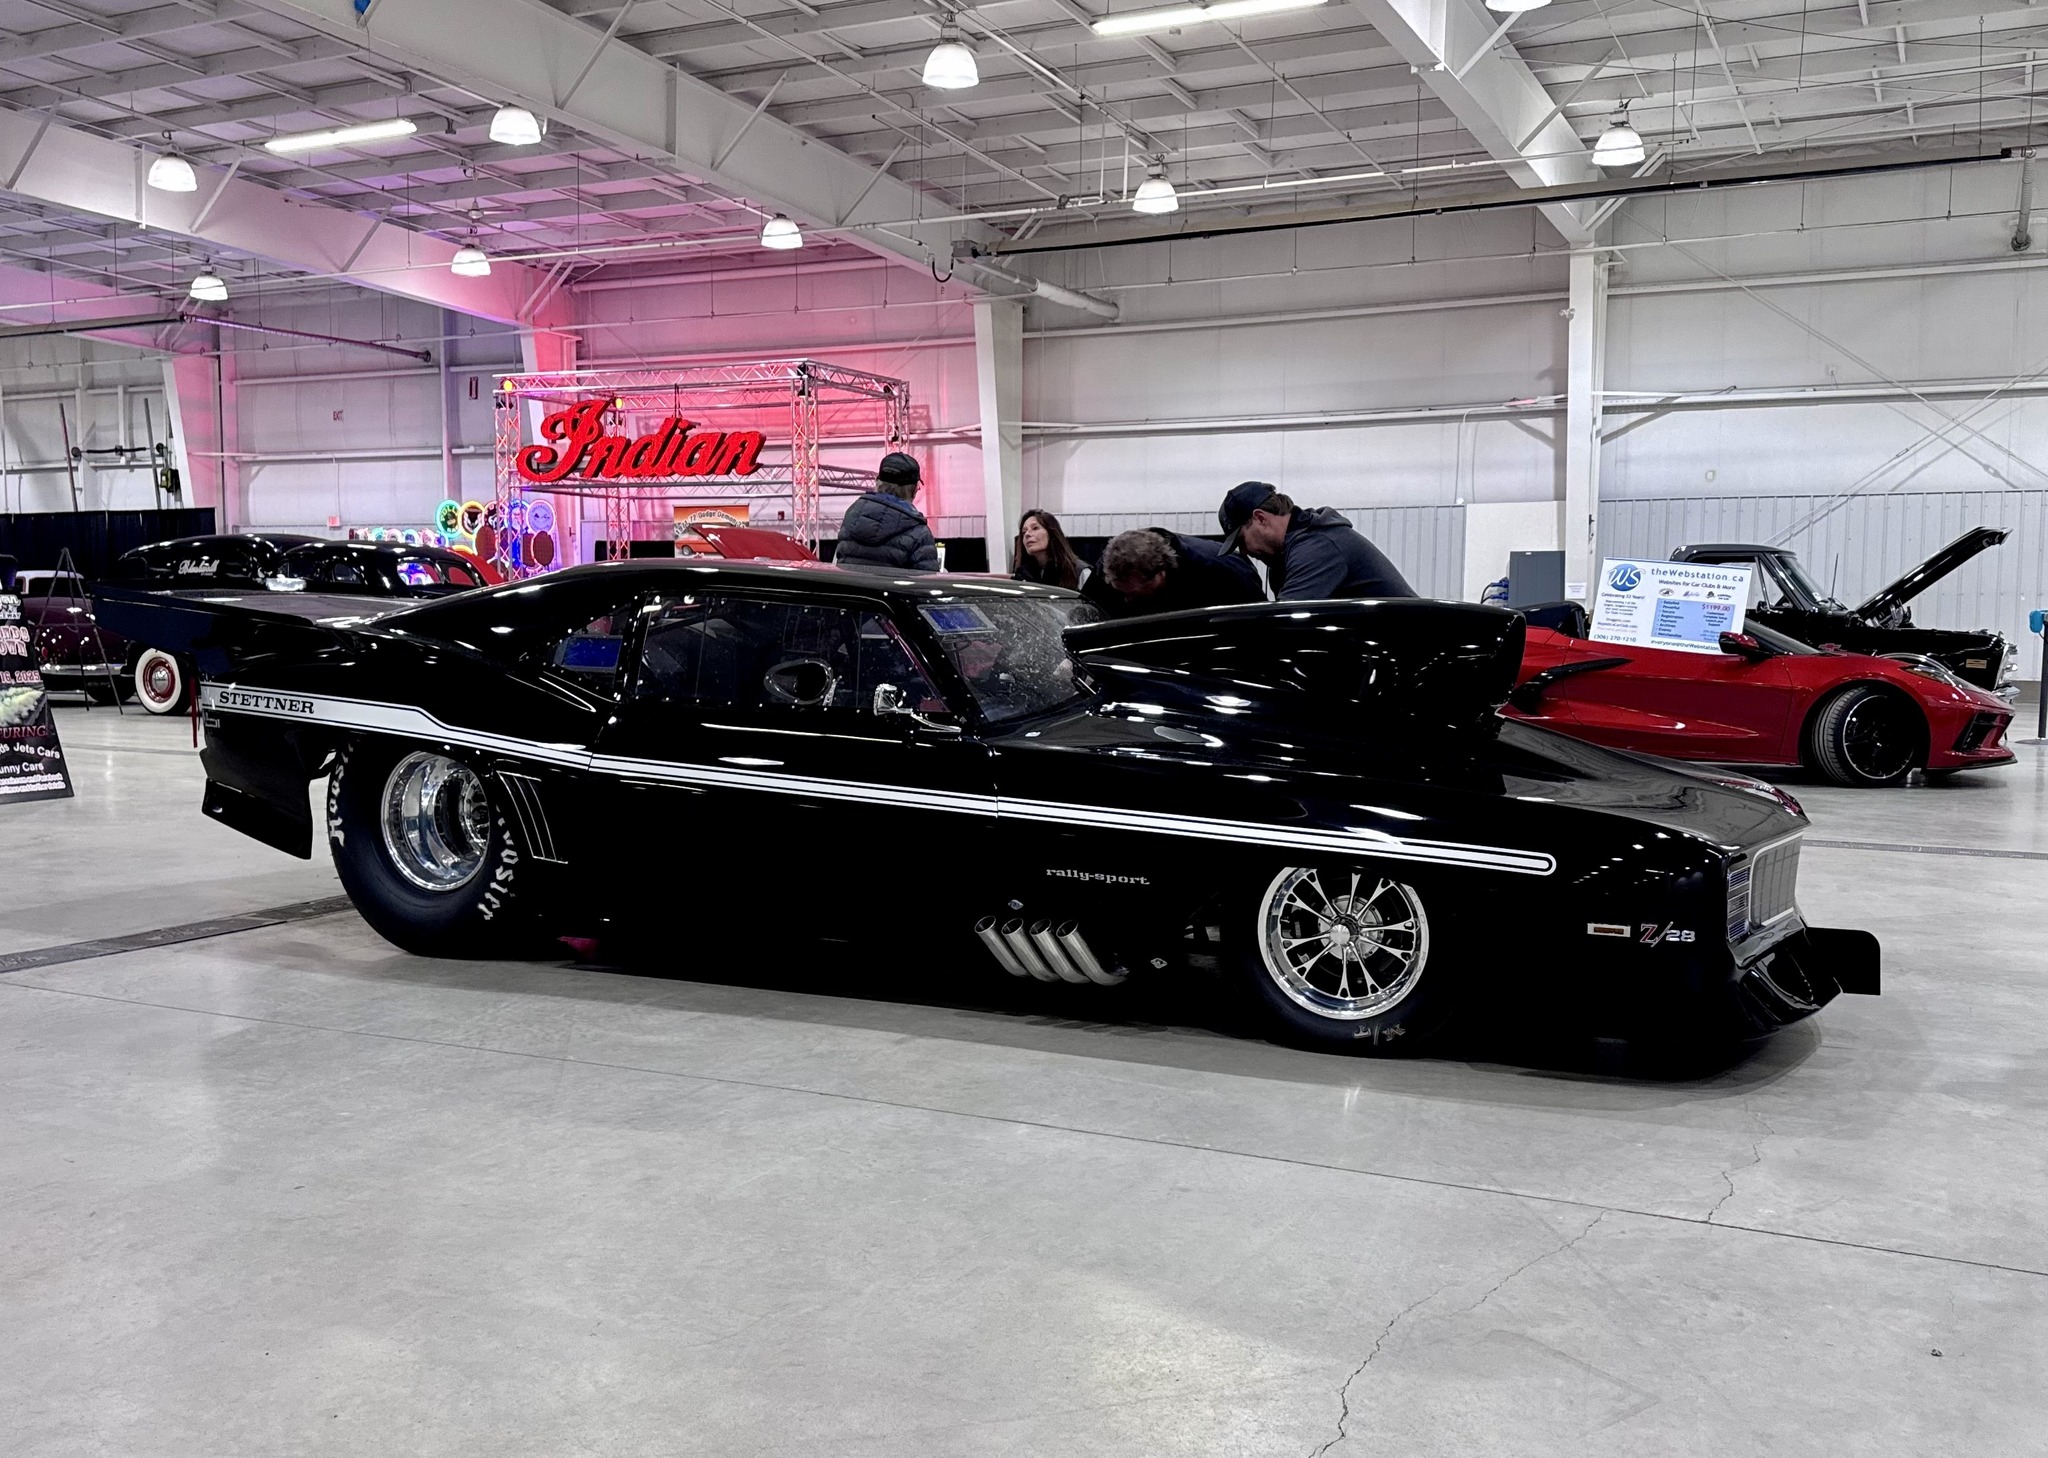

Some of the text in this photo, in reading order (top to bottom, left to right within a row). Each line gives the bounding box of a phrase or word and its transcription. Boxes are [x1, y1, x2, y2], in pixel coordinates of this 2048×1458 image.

[516, 399, 767, 483] Indian
[1608, 567, 1646, 588] WS
[1651, 567, 1744, 582] theWebstation.ca
[1702, 603, 1731, 611] $1199.00
[15, 670, 40, 683] 2025
[219, 691, 315, 714] STETTNER
[13, 742, 35, 754] Jets
[37, 746, 60, 759] Cars
[0, 762, 44, 775] unny Cars
[1046, 868, 1151, 885] rally-sport
[1639, 920, 1696, 948] Z/28
